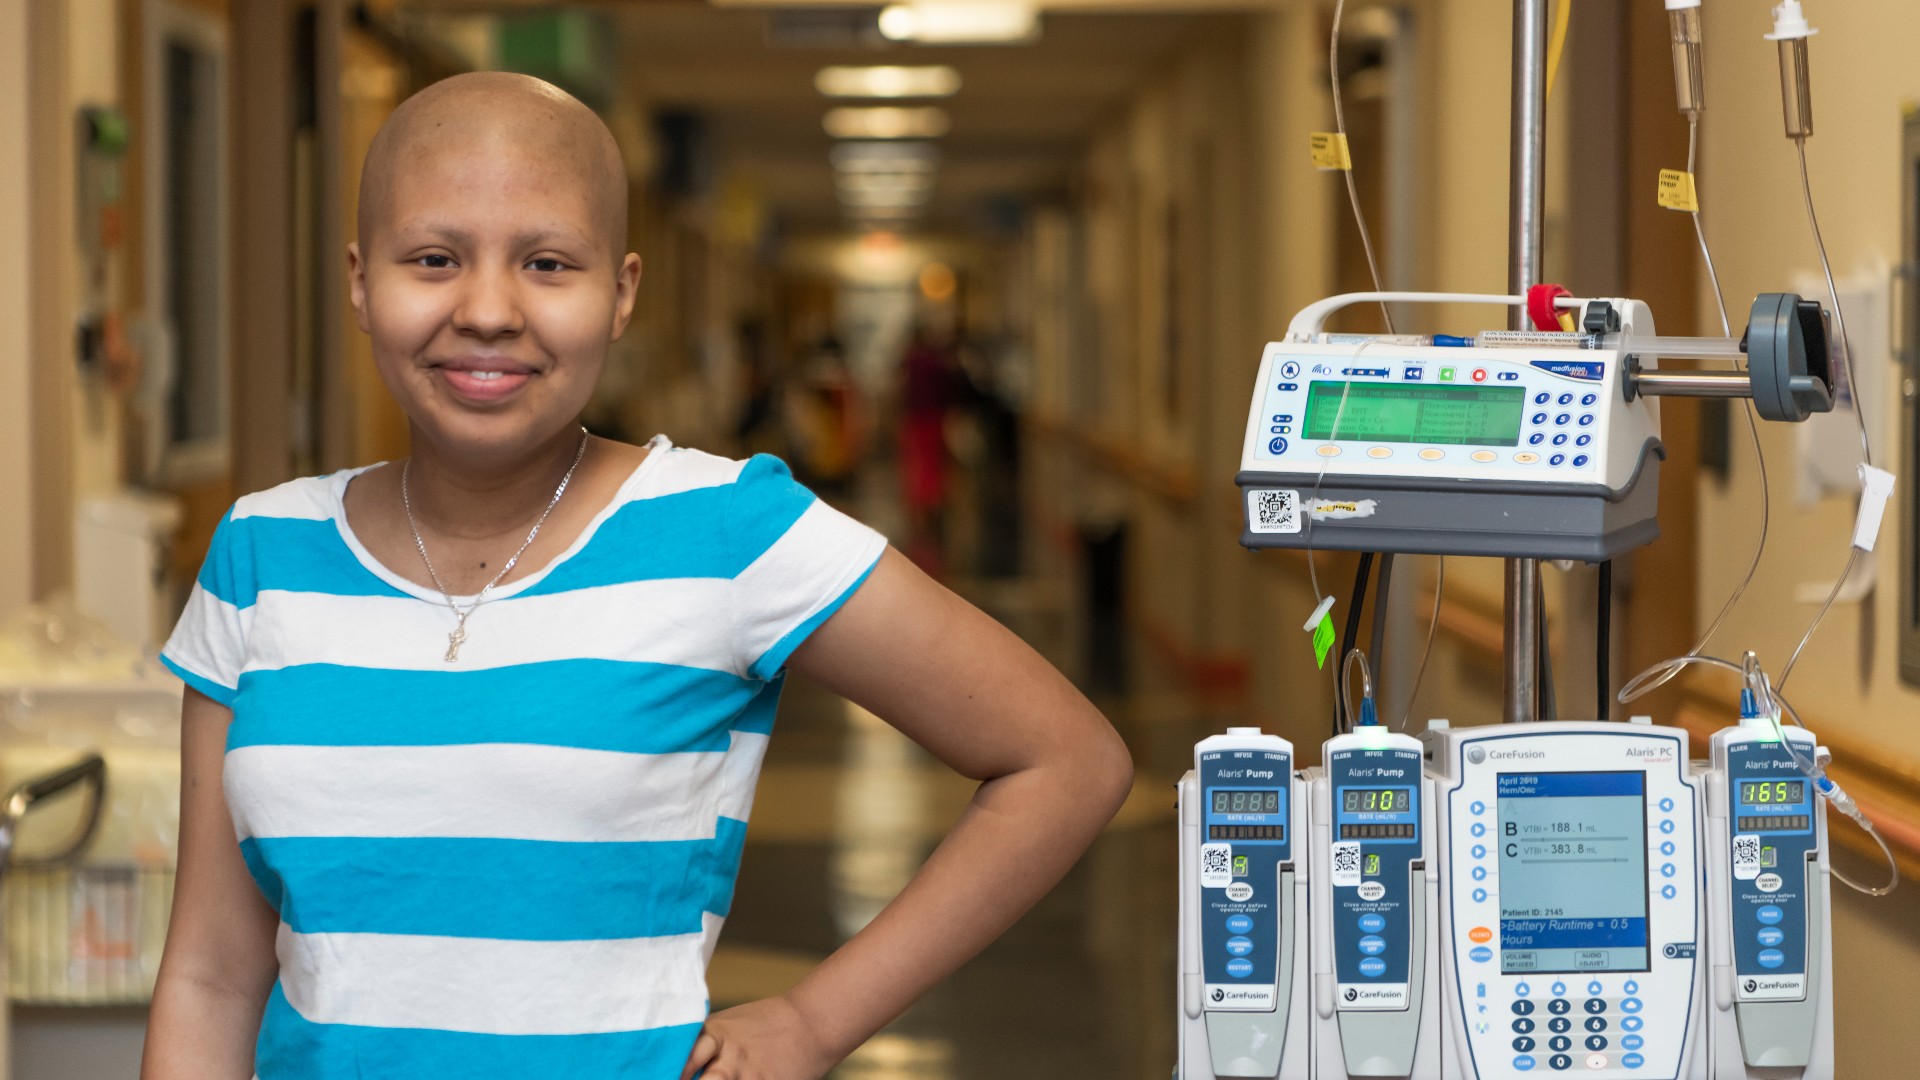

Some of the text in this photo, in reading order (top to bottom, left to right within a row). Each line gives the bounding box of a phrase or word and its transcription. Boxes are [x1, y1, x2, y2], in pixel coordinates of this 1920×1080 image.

[1489, 749, 1545, 759] CareFusion
[1660, 747, 1672, 756] PC
[1731, 745, 1748, 753] ALARM
[1264, 753, 1287, 761] STANDBY
[1334, 752, 1351, 760] ALARM
[1773, 761, 1799, 770] Pump
[1246, 769, 1273, 779] Pump
[1377, 768, 1404, 778] Pump
[1499, 777, 1518, 785] April
[1749, 782, 1787, 802] 165
[1370, 791, 1393, 810] 10
[1505, 822, 1518, 836] B
[1523, 825, 1541, 833] VTBI
[1505, 843, 1518, 857] C
[1233, 856, 1247, 873] A
[1548, 919, 1594, 930] Runtime
[1610, 919, 1628, 930] 0.5
[1501, 934, 1533, 945] Hours
[1519, 1002, 1525, 1012] 1
[1556, 1001, 1563, 1011] 2
[1592, 1001, 1600, 1011] 3
[1519, 1021, 1526, 1031] 4
[1557, 1020, 1564, 1030] 5
[1592, 1019, 1600, 1029] 6
[1521, 1040, 1528, 1049] 7
[1557, 1039, 1564, 1049] 8
[1593, 1038, 1601, 1048] 9
[1557, 1057, 1565, 1067] 0
